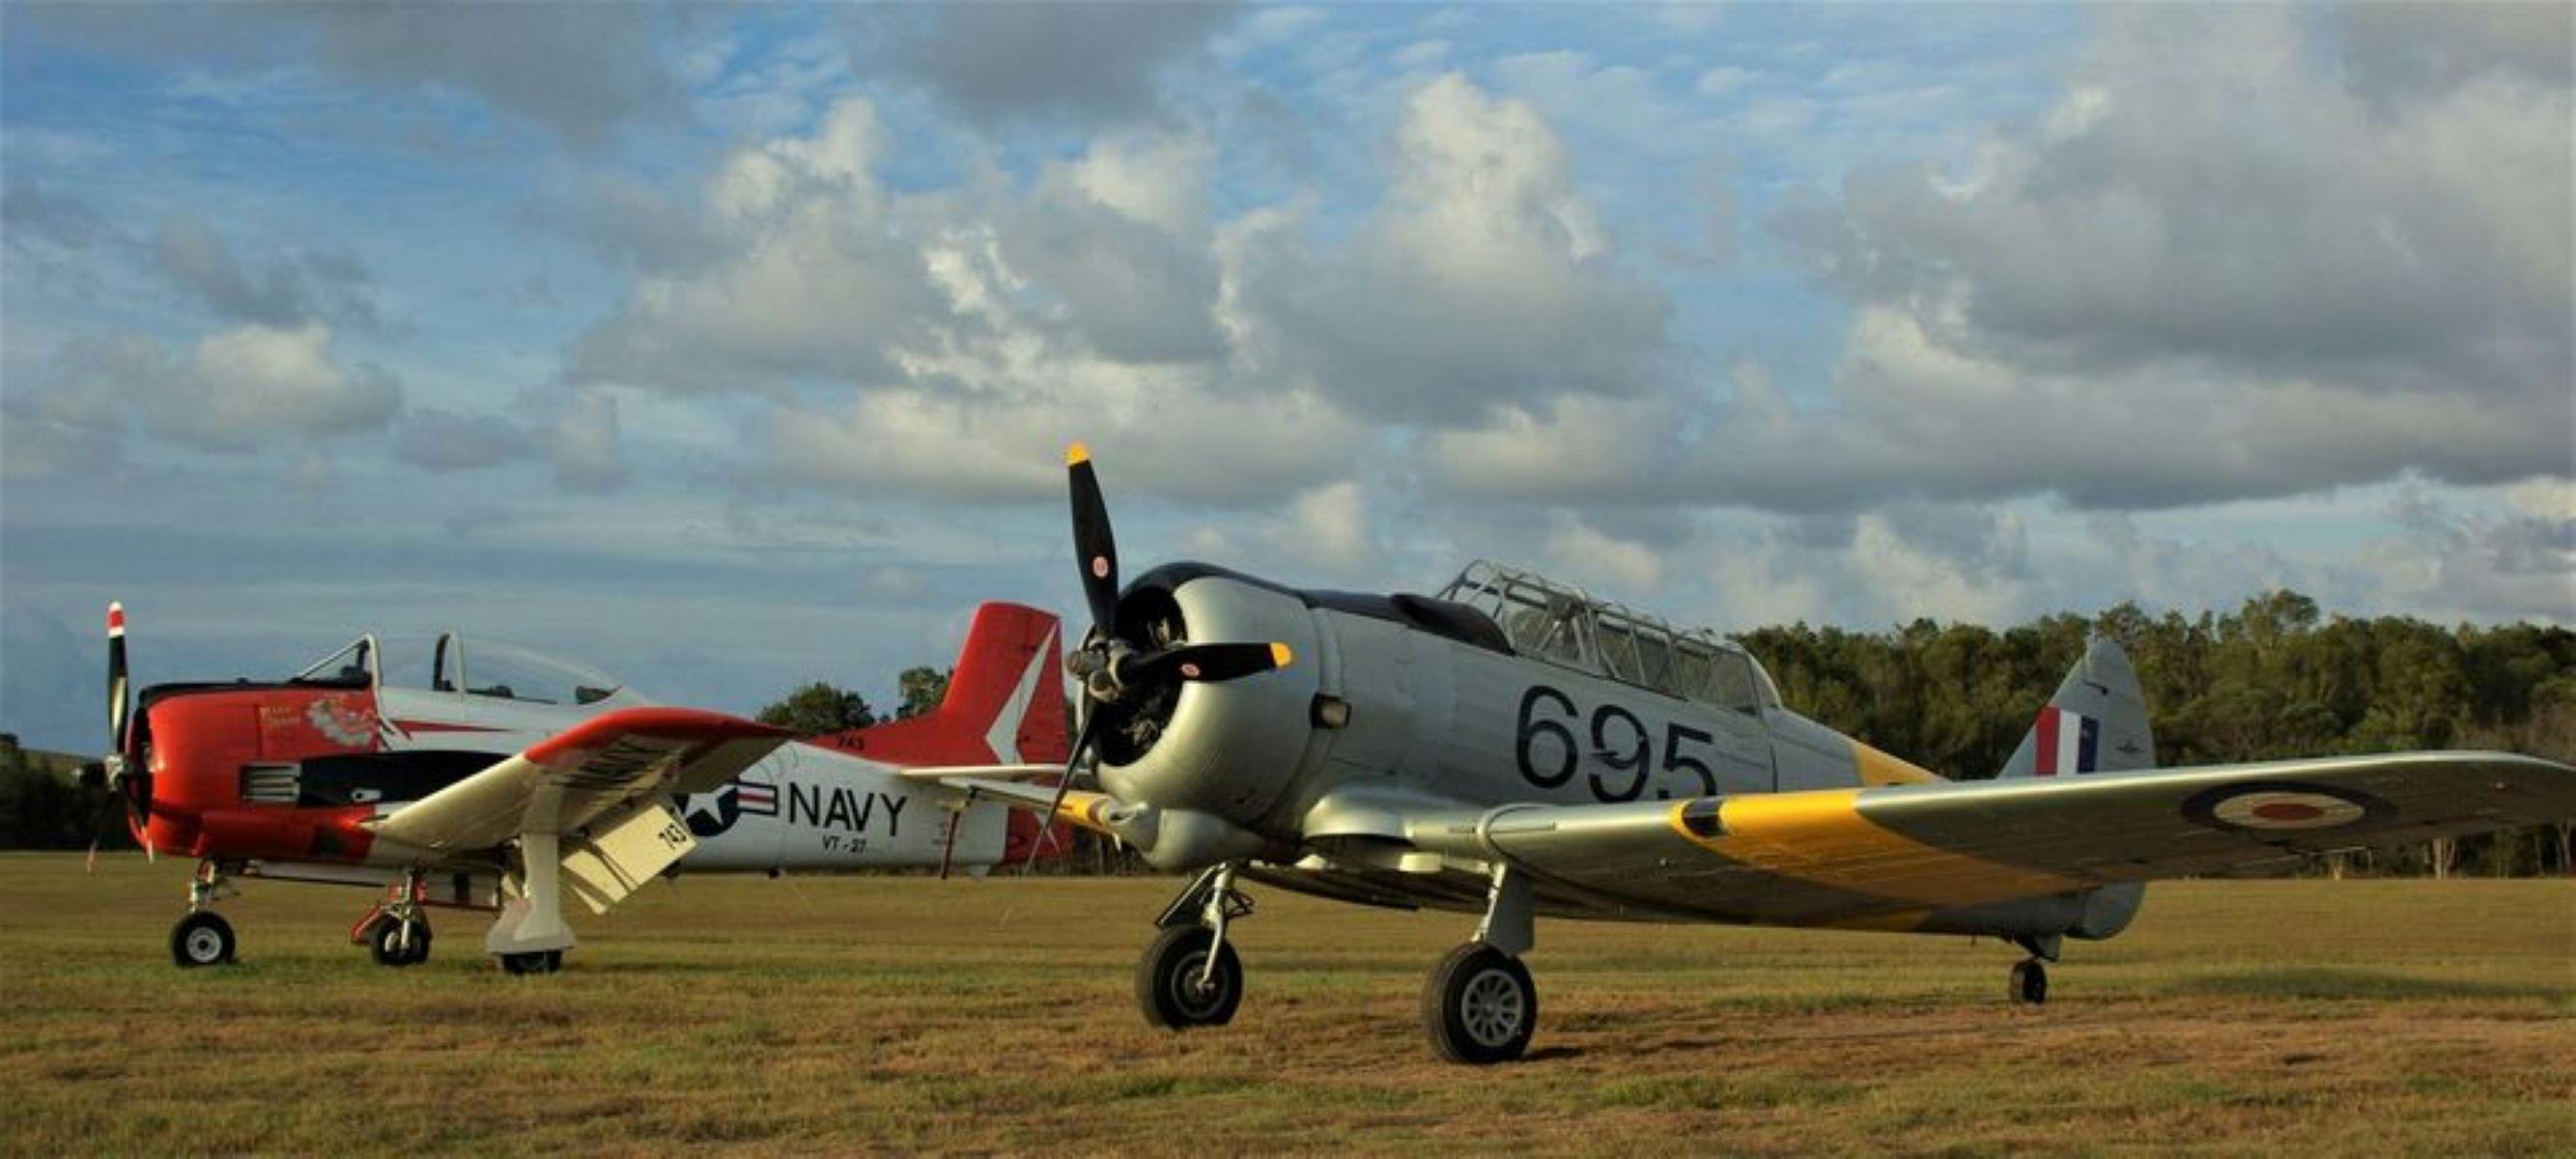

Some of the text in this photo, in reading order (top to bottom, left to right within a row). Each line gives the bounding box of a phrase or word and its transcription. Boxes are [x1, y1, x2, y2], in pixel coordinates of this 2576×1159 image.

[1516, 685, 1717, 804] 695
[789, 781, 908, 836] NAVY
[658, 823, 687, 850] 743
